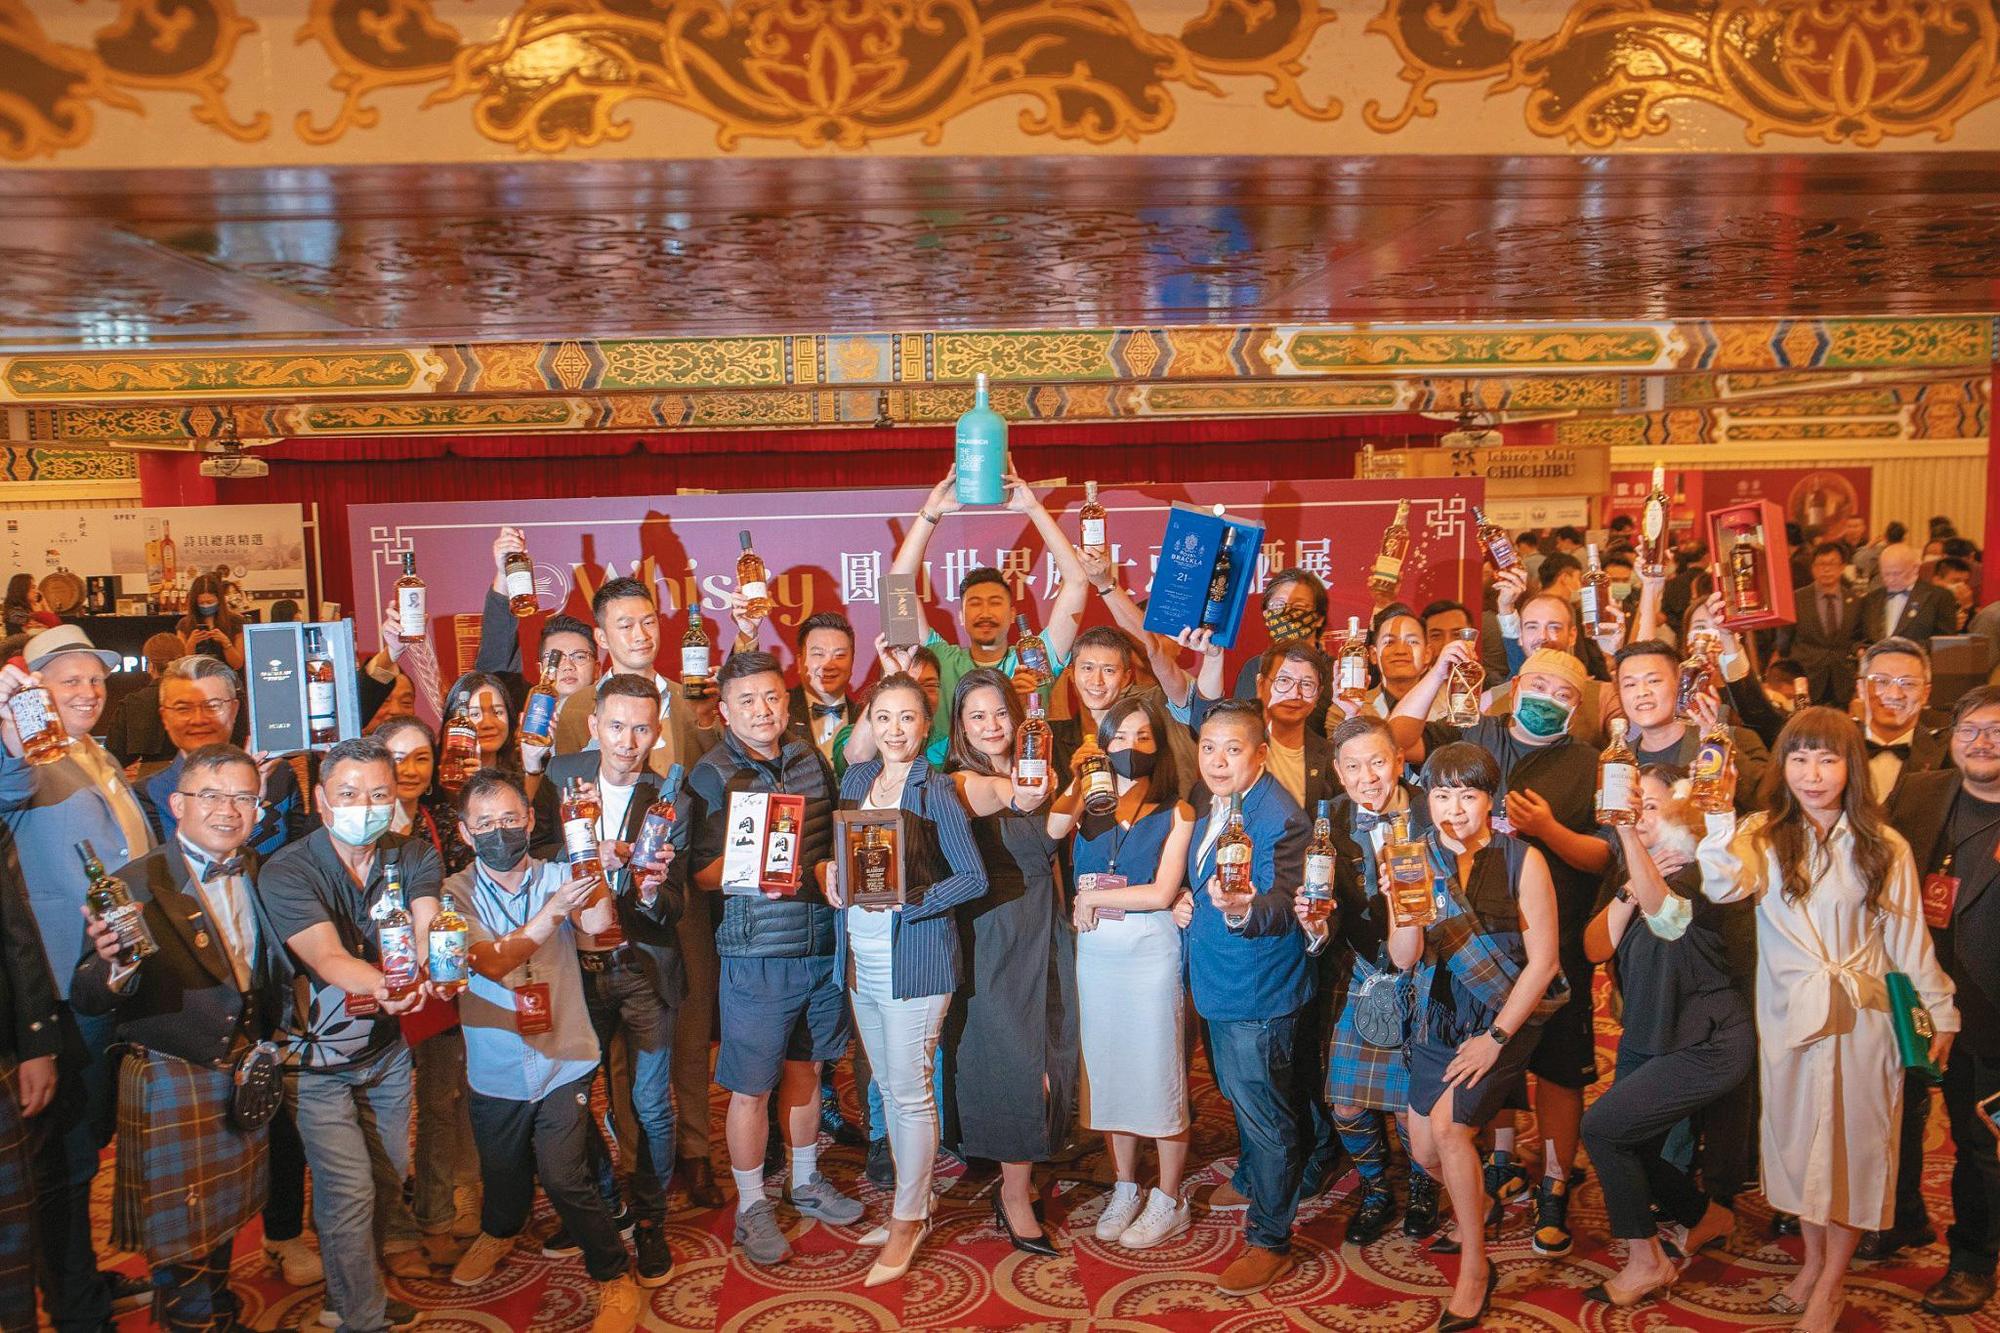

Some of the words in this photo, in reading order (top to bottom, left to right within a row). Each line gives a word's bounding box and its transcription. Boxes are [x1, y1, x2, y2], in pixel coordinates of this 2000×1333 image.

[1487, 450, 1539, 462] Ichiro's
[1544, 449, 1576, 460] Malt
[1487, 463, 1576, 478] CHICHIBU
[1171, 554, 1202, 566] BRACKLA
[1177, 572, 1188, 582] 21
[568, 555, 815, 627] Whisy
